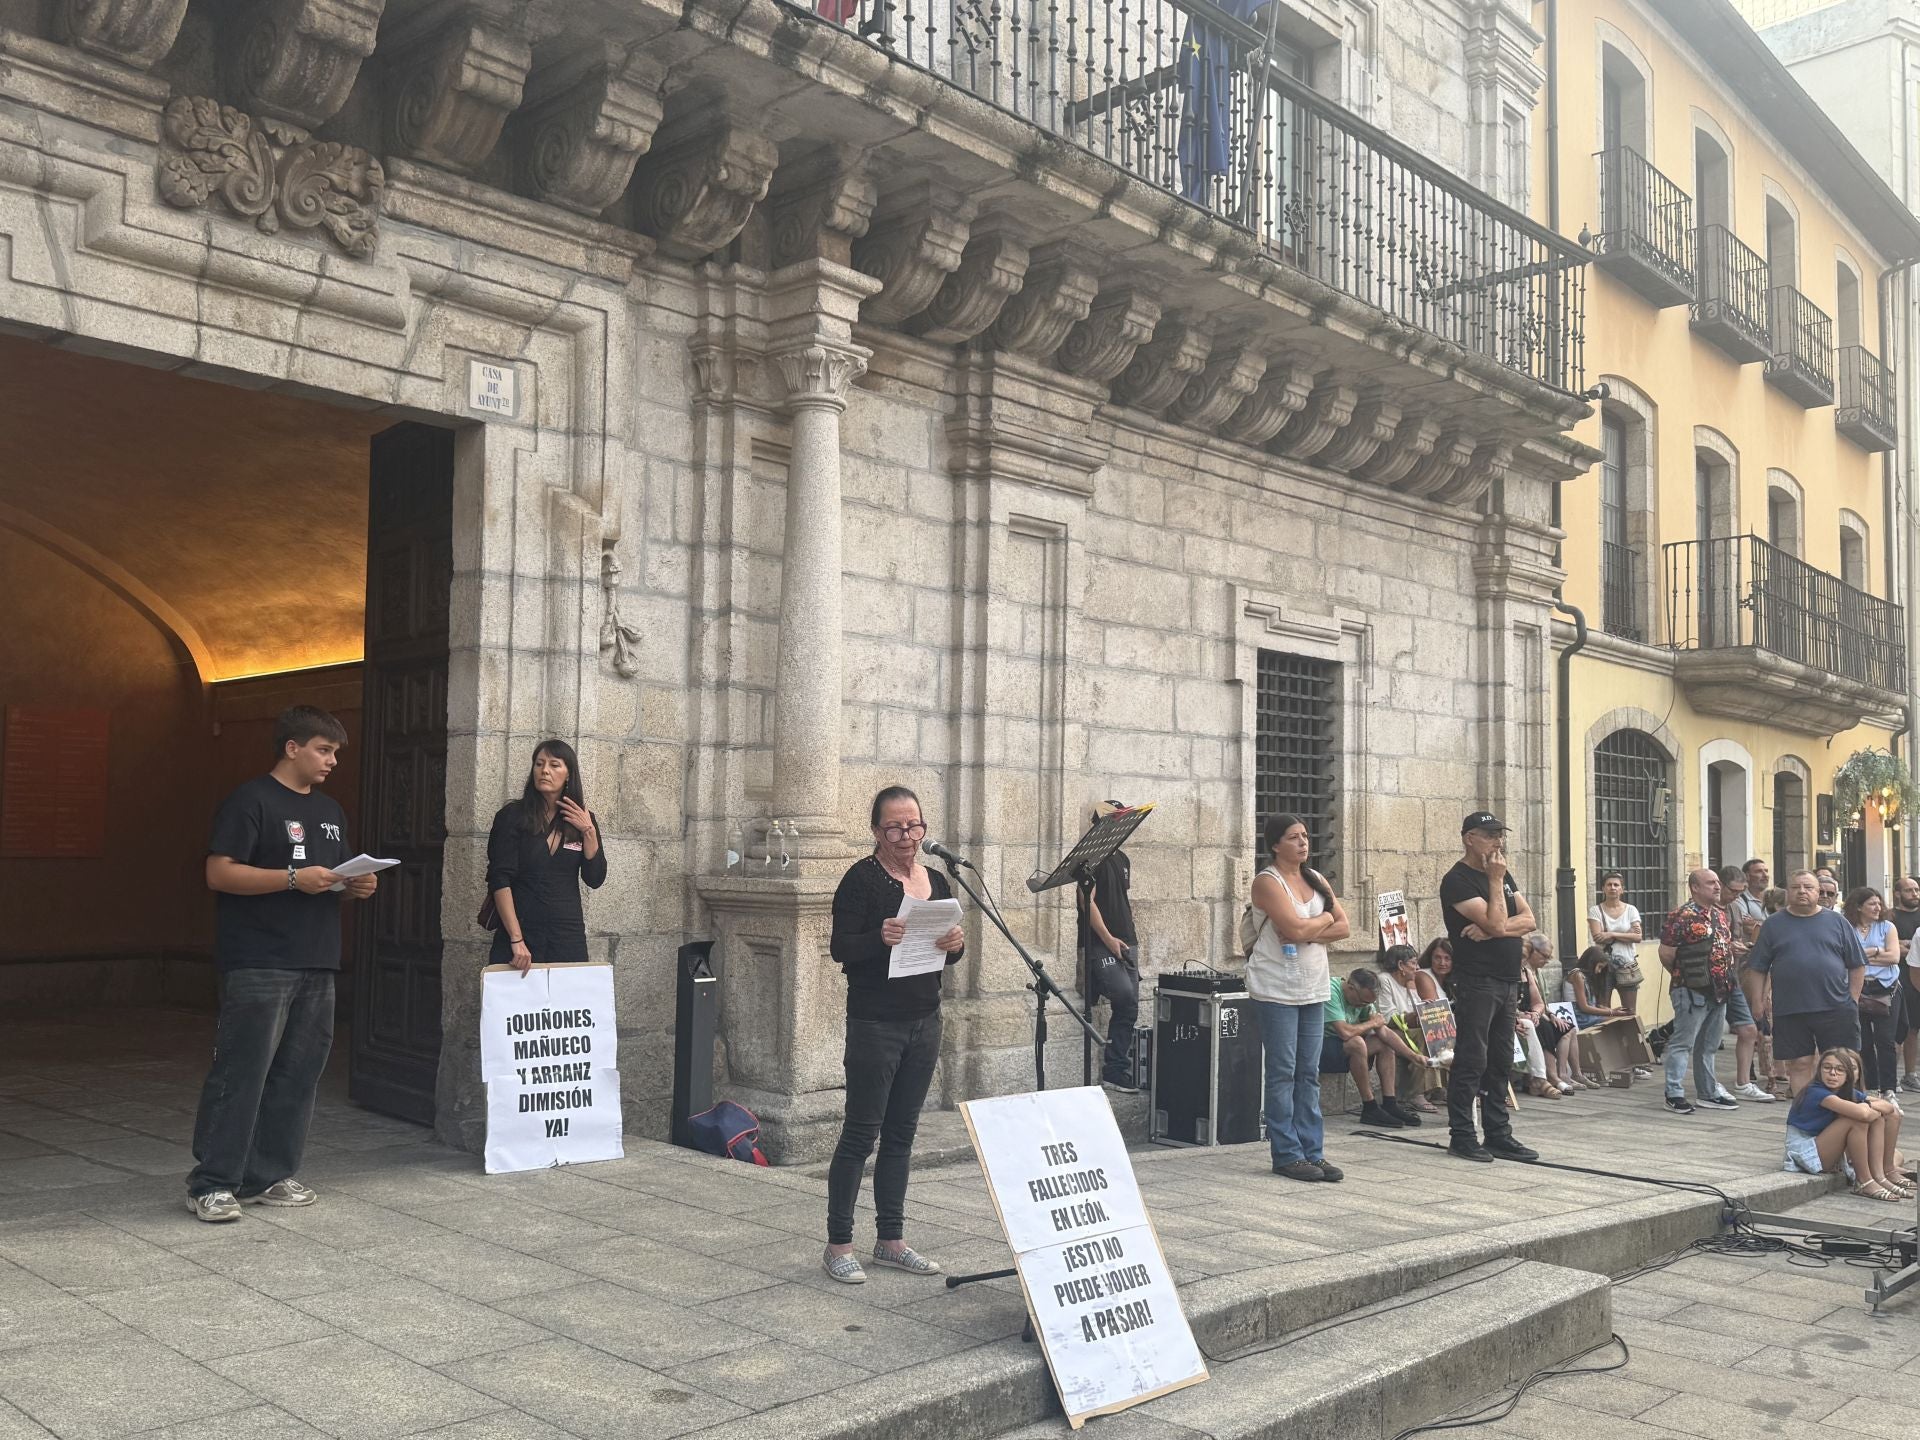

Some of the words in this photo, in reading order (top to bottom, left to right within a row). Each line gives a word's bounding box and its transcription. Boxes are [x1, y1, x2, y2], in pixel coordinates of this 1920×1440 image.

[482, 366, 502, 381] CASA
[487, 381, 499, 394] DE
[1102, 956, 1116, 969] JLD
[506, 1008, 596, 1036] ¡QUIÑONES,
[1172, 1024, 1199, 1042] JLD
[513, 1035, 591, 1060] MAÑUECO
[516, 1067, 527, 1085] Y
[531, 1062, 592, 1085] ARRANZ
[518, 1086, 593, 1113] DIMISIÓN
[544, 1117, 569, 1138] YA!
[1040, 1141, 1079, 1167] TRES
[1028, 1168, 1109, 1203] FALLECIDOS
[1050, 1208, 1072, 1232] EN
[1070, 1199, 1110, 1228] LEÓN.
[1062, 1241, 1103, 1273] ¡ESTO
[1102, 1236, 1124, 1261] NO
[1054, 1276, 1104, 1308] PUEDE
[1101, 1263, 1152, 1296] VOLVER
[1080, 1315, 1098, 1343] A
[1094, 1298, 1155, 1339] PASAR!
